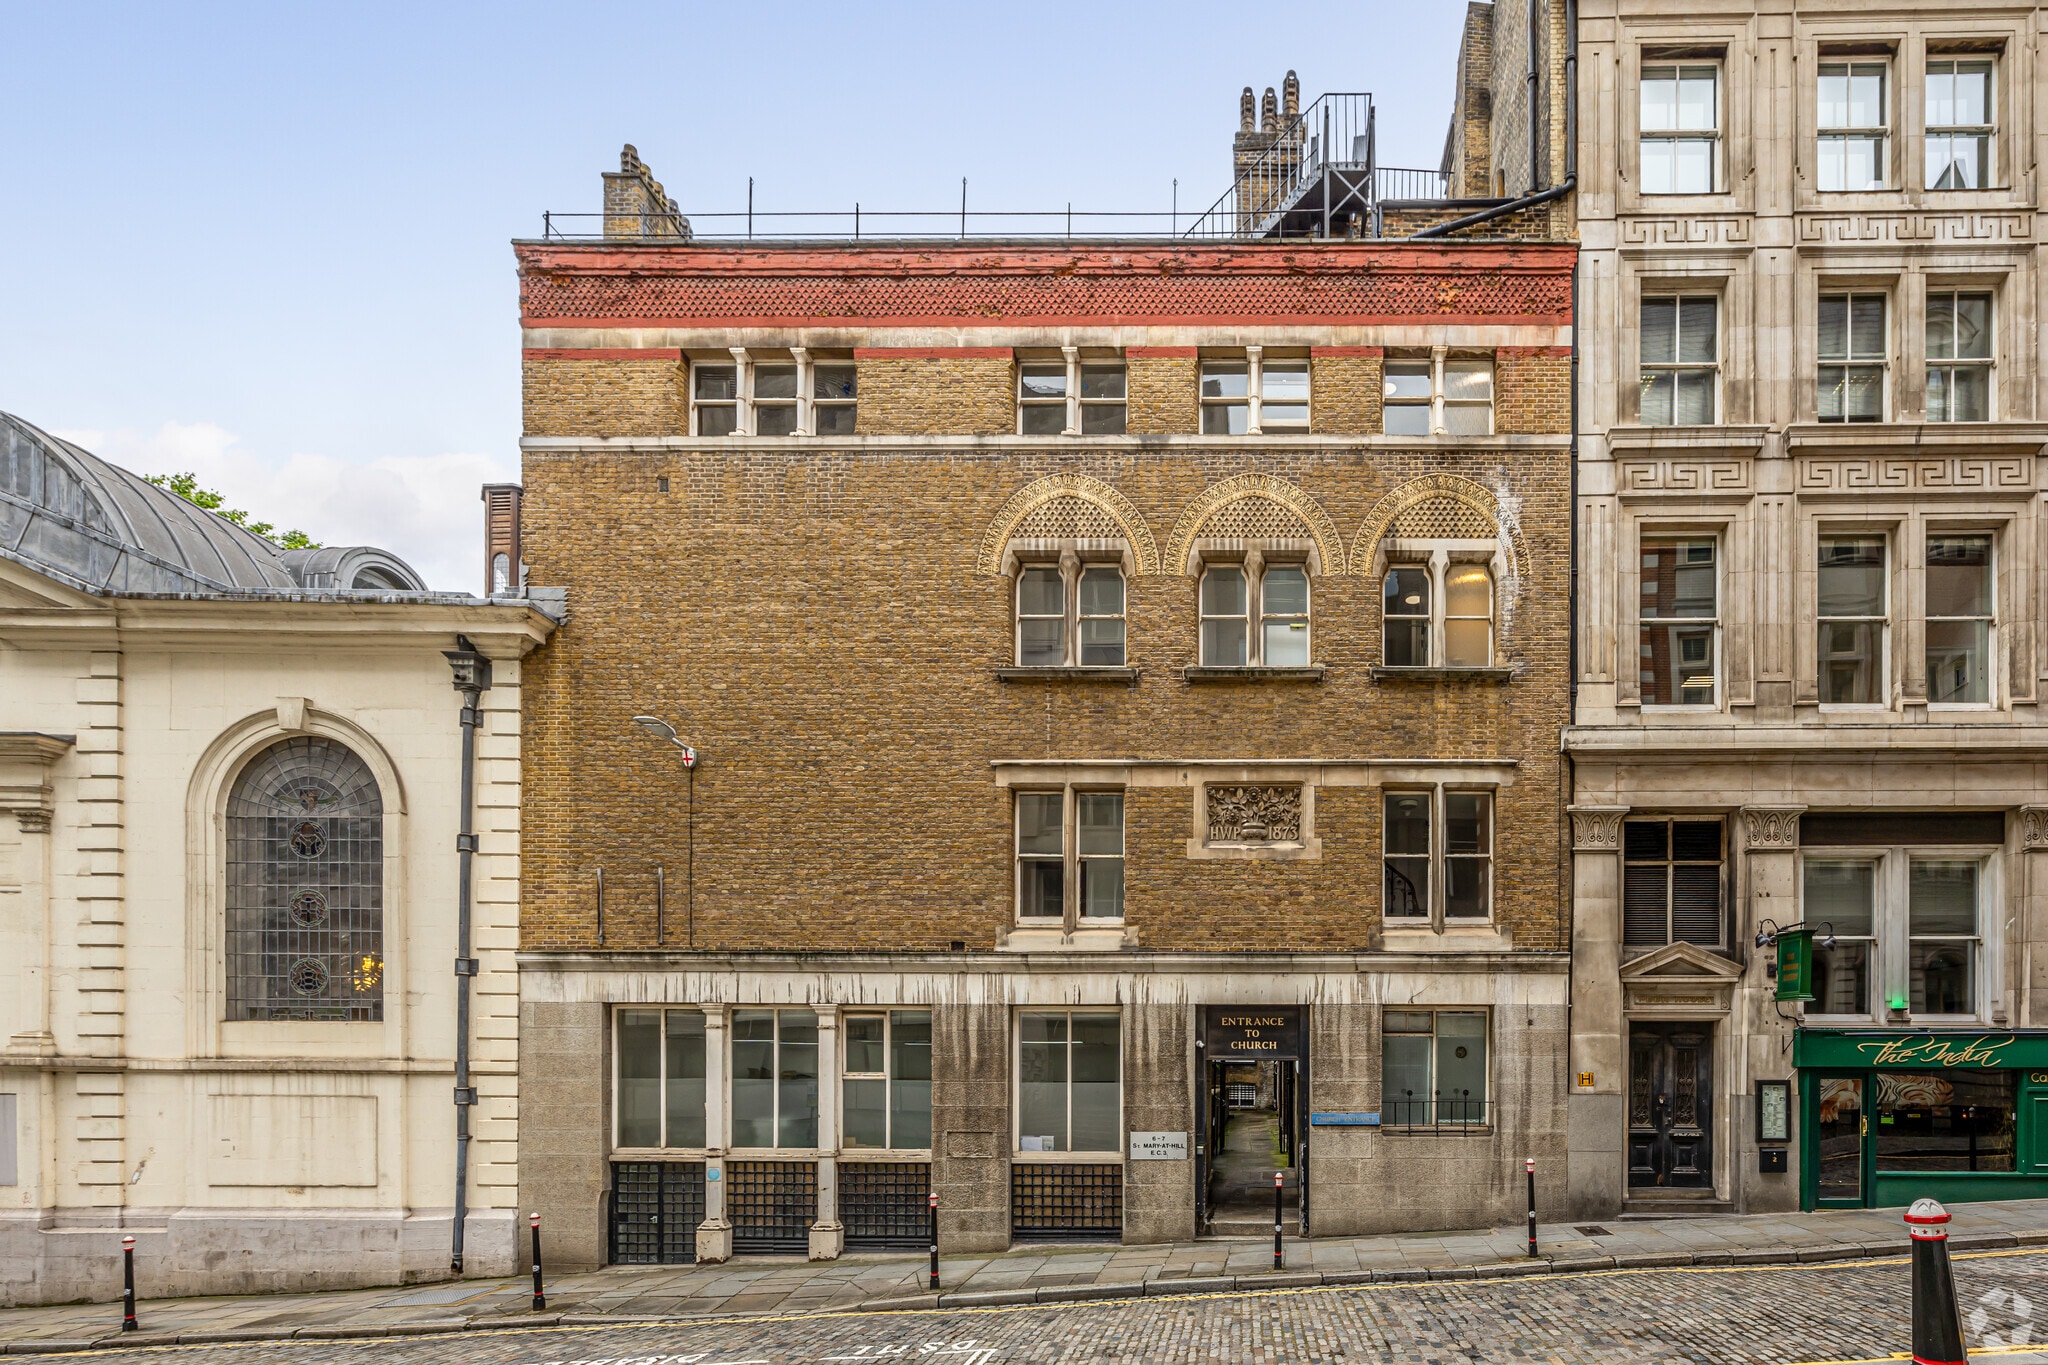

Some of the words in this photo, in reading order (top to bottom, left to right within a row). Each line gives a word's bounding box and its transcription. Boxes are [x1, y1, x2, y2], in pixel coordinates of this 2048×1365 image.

[1210, 826, 1241, 840] HWP
[1268, 826, 1299, 840] 1873
[1221, 1017, 1284, 1026] ENTRANCE
[1244, 1029, 1260, 1038] TO
[1230, 1041, 1277, 1050] CHURCH
[1857, 1035, 1934, 1065] The
[1920, 1035, 2015, 1067] India
[1581, 1073, 1591, 1085] H
[1344, 1115, 1375, 1123] ENTRANCE
